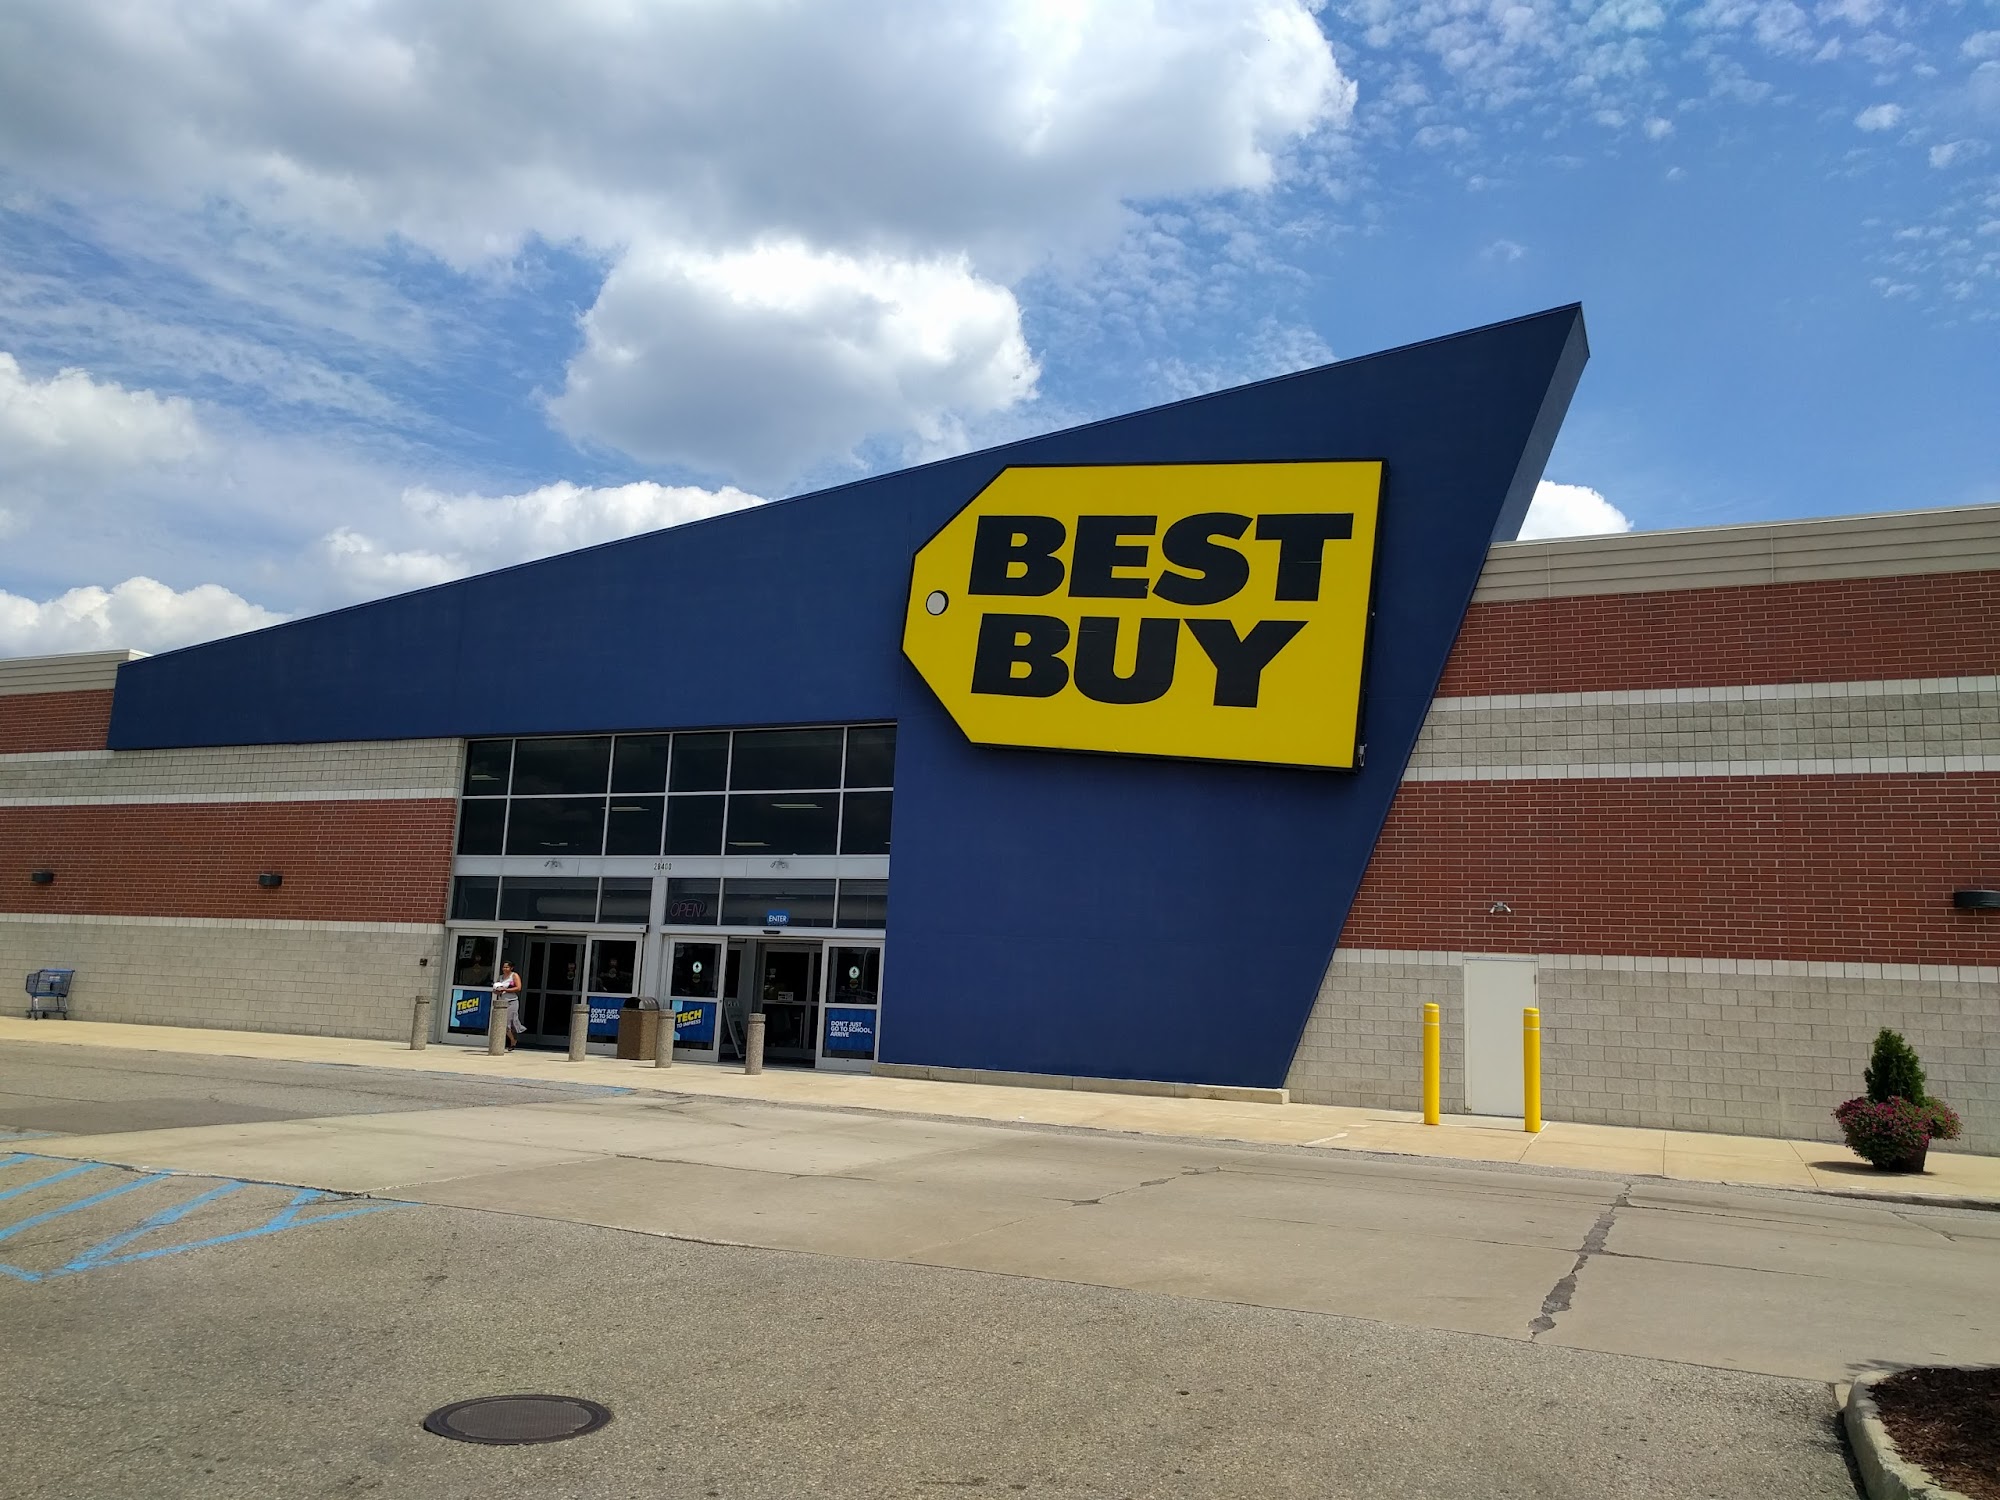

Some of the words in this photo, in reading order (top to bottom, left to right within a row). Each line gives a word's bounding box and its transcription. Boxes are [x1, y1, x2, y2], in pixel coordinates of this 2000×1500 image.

[968, 512, 1354, 606] BEST
[971, 613, 1309, 708] BUY
[670, 902, 702, 917] OPEN
[457, 997, 479, 1011] TECH
[676, 1009, 702, 1023] TECH
[683, 1019, 702, 1027] IMPRESS
